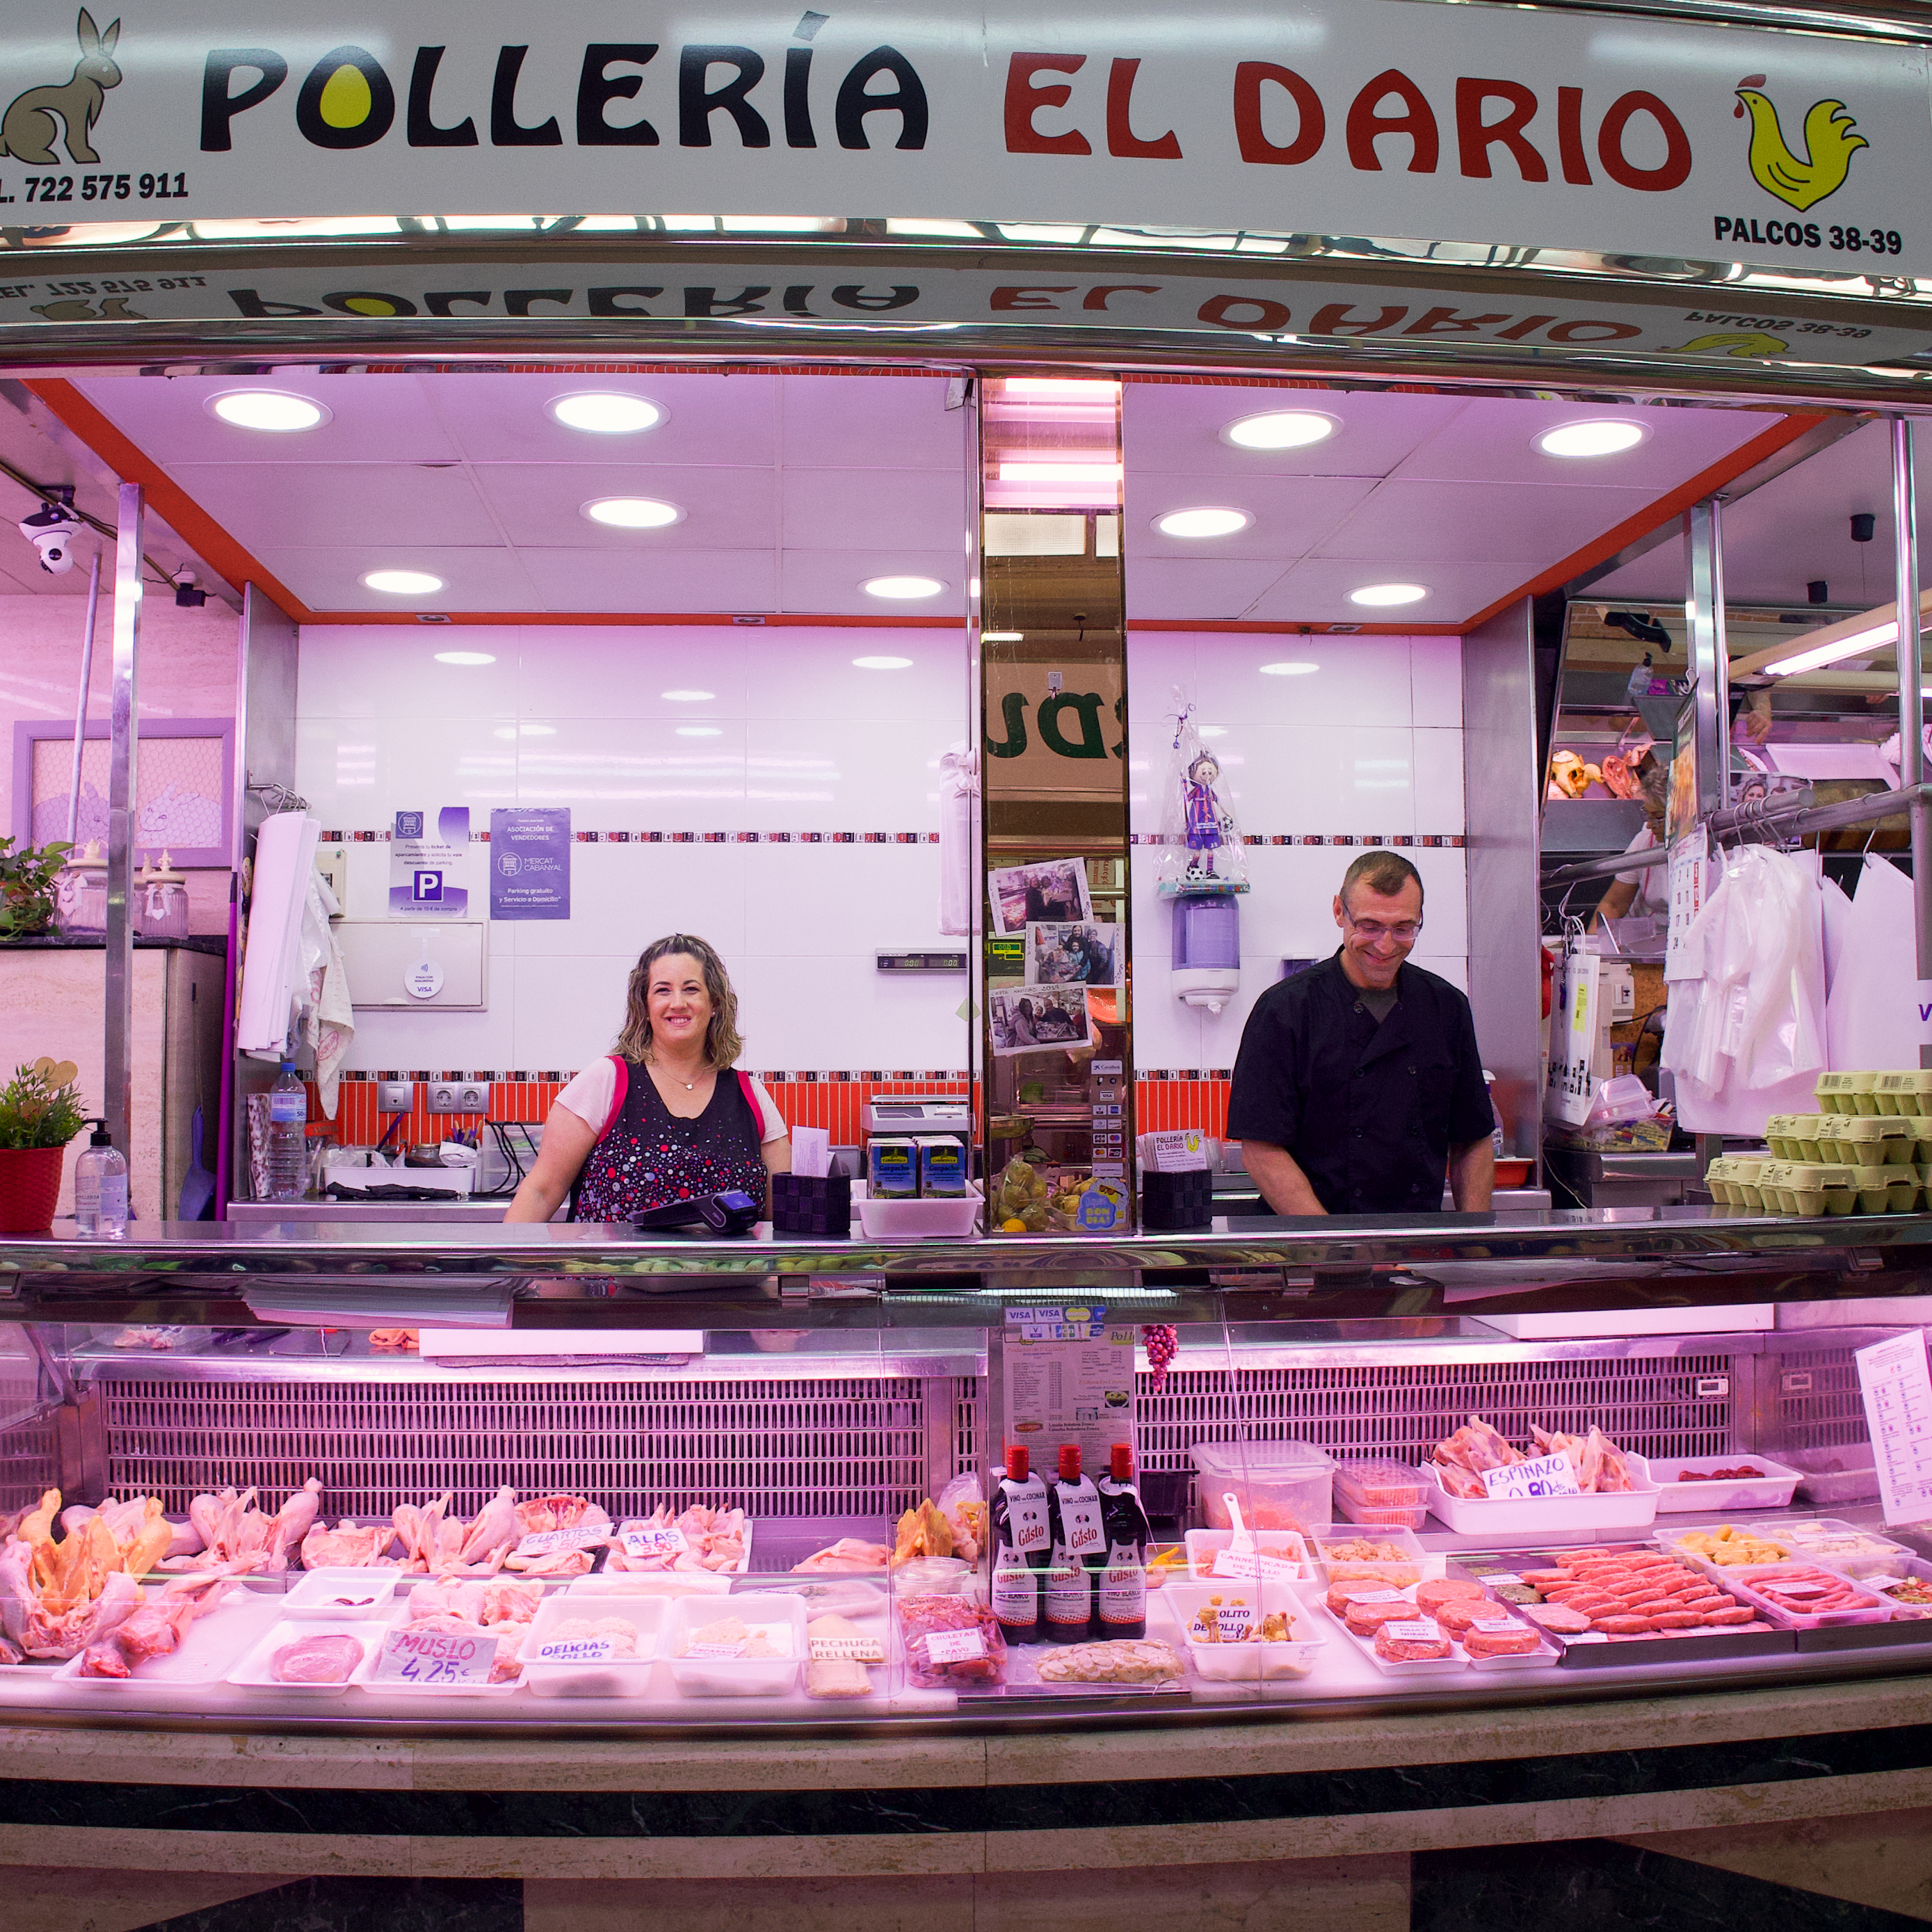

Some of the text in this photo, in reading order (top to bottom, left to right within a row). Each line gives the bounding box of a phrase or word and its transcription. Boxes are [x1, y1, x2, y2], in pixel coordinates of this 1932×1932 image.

[200, 11, 1692, 191] POLLERÍA EL DARIO
[25, 177, 73, 202] 722
[81, 175, 131, 200] 575
[139, 172, 188, 198] 911
[1714, 216, 1902, 255] PALCOS 38-39
[419, 874, 439, 899] P
[1490, 1458, 1564, 1487] ESPINAZO
[1027, 1492, 1045, 1501] COCINAR
[1079, 1495, 1098, 1503] COCINAR
[526, 1527, 602, 1544] CUARTOS
[629, 1531, 679, 1545] ALAS
[537, 1537, 581, 1552] 3.50
[641, 1542, 673, 1554] 3.90
[1221, 1553, 1255, 1563] CARNE
[1218, 1623, 1244, 1632] OLLO
[931, 1630, 976, 1641] CHULETAS
[392, 1634, 476, 1660] MUSLO
[810, 1639, 881, 1648] PECHUGA
[815, 1650, 881, 1659] RELLENA
[401, 1656, 460, 1683] 4.25
